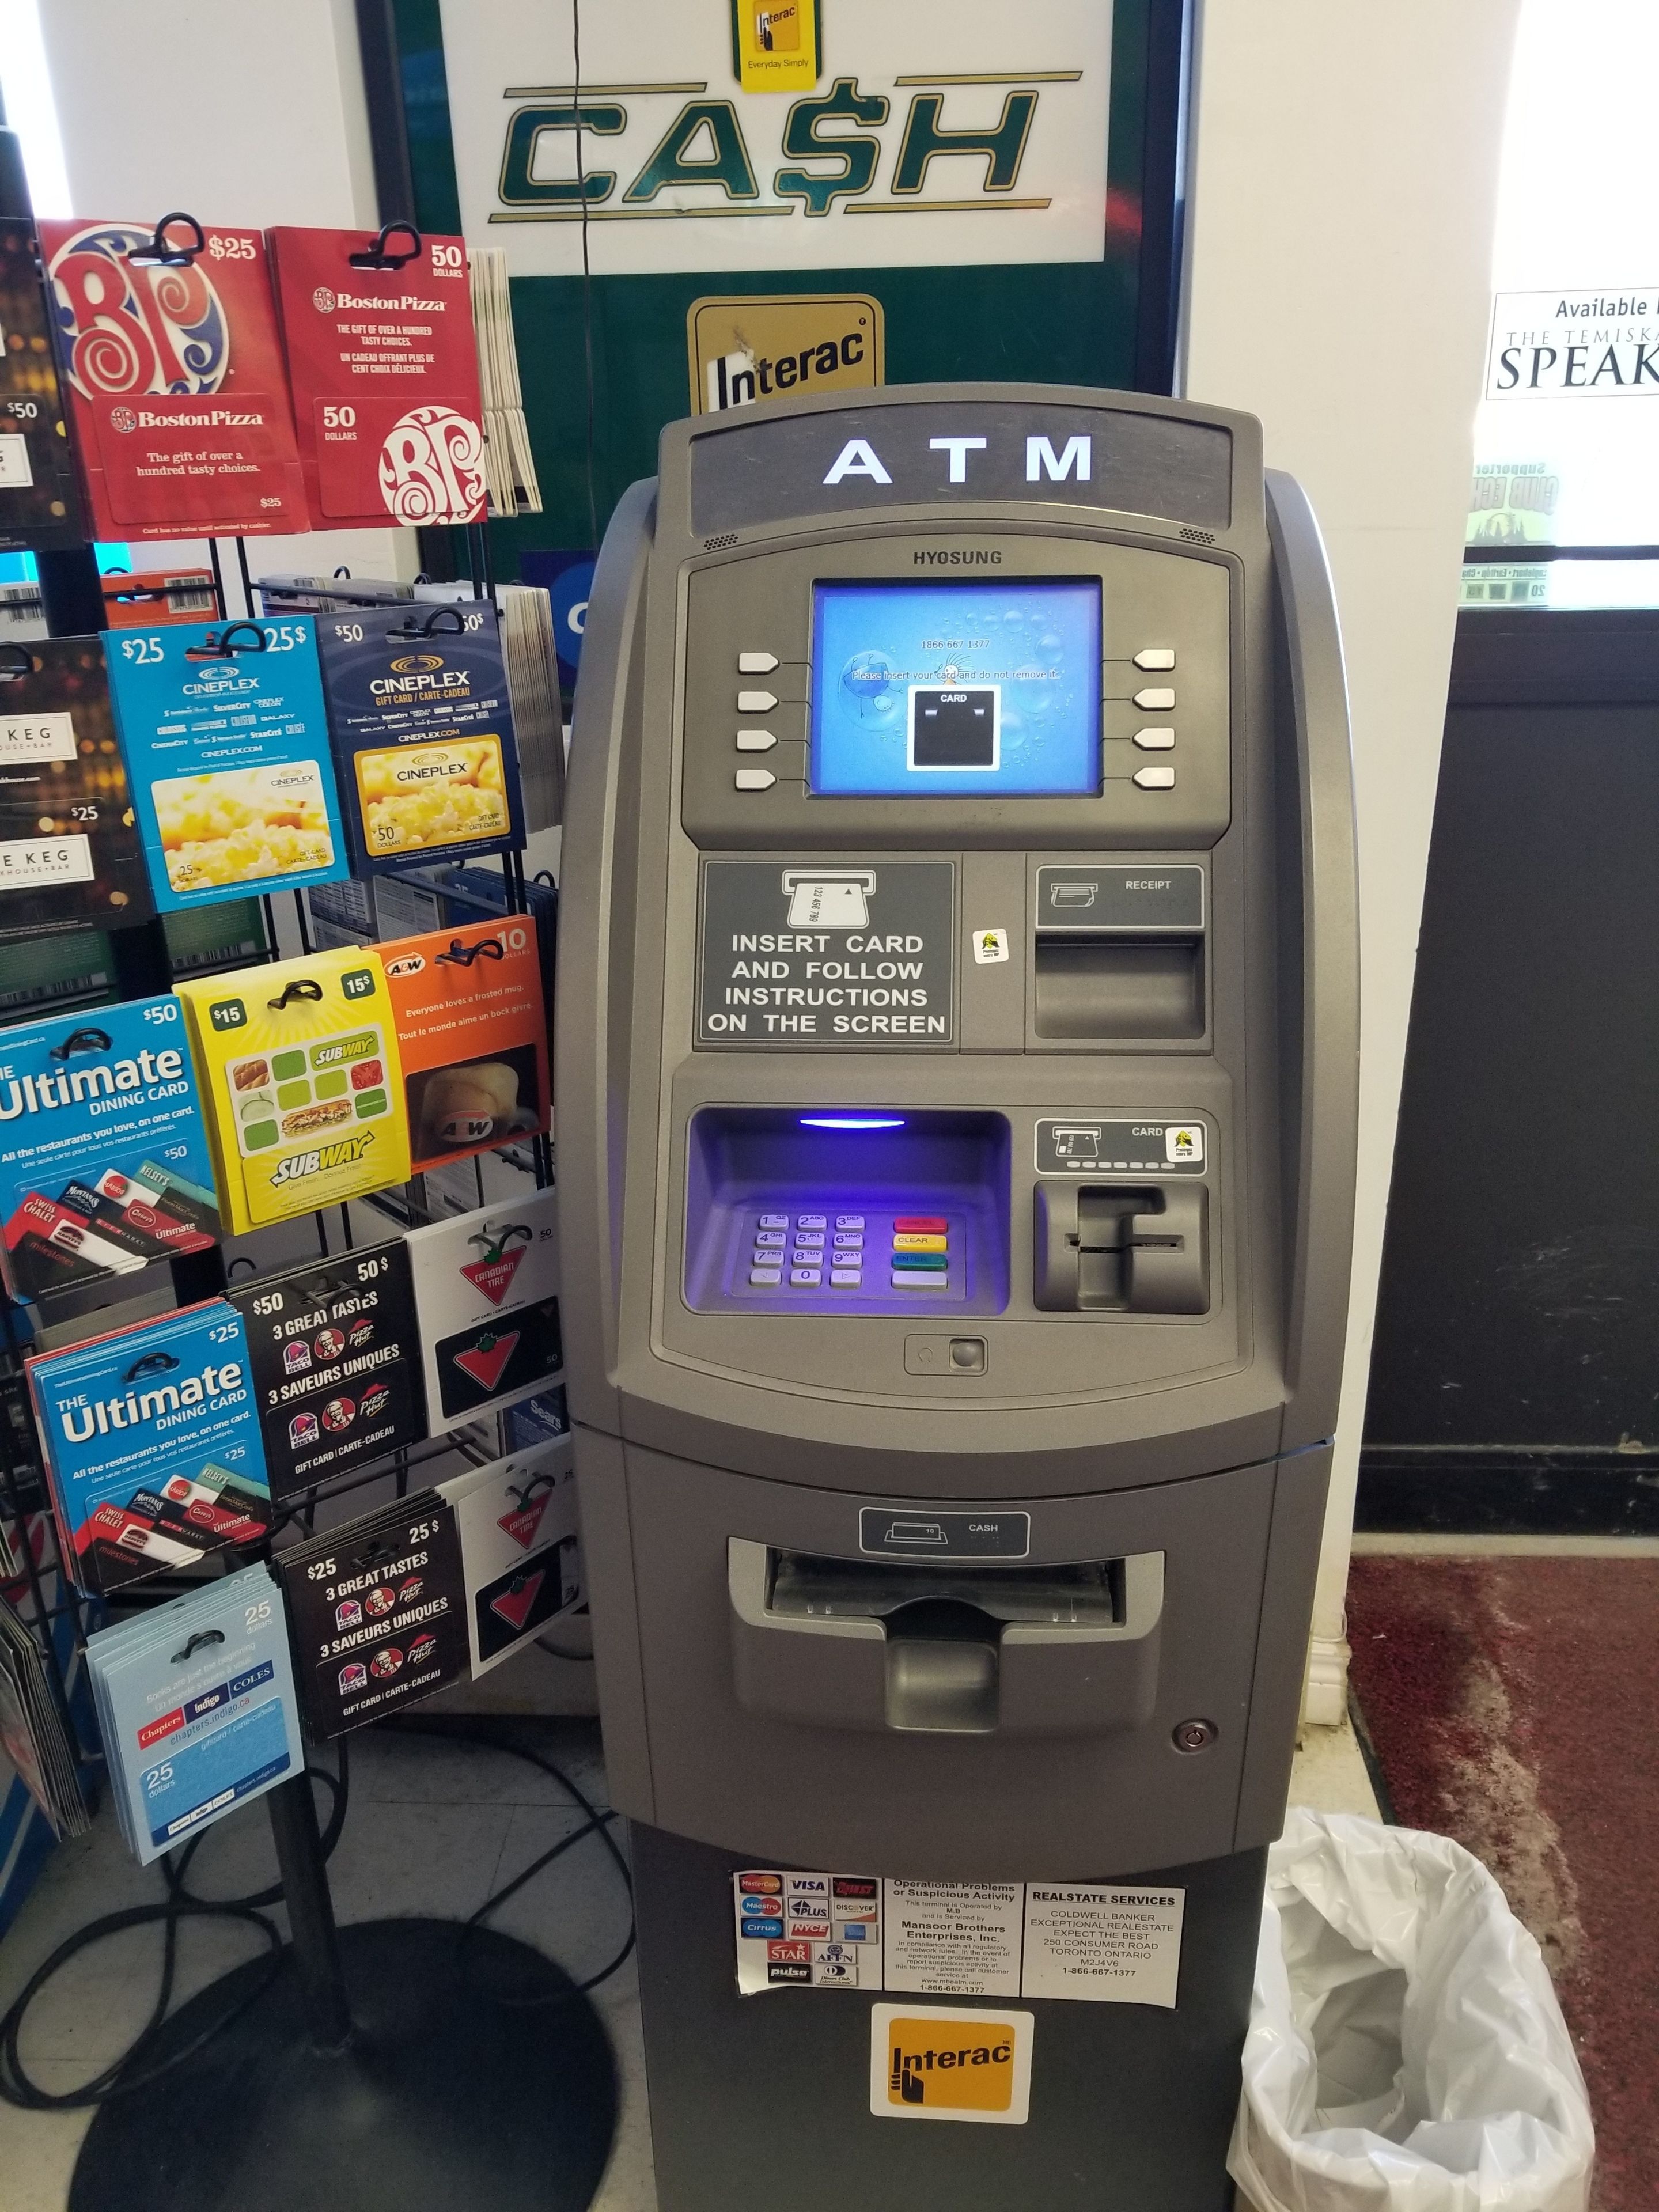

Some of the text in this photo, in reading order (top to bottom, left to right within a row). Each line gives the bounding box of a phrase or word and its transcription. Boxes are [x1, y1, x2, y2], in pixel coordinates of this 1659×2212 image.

[759, 7, 796, 33] Interac
[748, 59, 808, 70] Everyday Simply
[208, 235, 256, 260] $25
[431, 245, 461, 267] 50
[1555, 297, 1647, 318] Available
[1506, 331, 1550, 346] THE
[717, 332, 864, 410] Interac
[1497, 343, 1659, 390] SPEAK
[323, 407, 356, 427] 50
[325, 431, 357, 441] DOLLARS
[147, 453, 169, 462] The
[173, 452, 192, 463] gift
[195, 452, 207, 460] of
[822, 435, 1092, 484] ATM
[137, 464, 260, 476] hundred tasty choices.
[914, 551, 1002, 565] HYOSUNG
[266, 626, 307, 652] 25$
[335, 624, 363, 642] $50
[121, 637, 164, 664] $25
[921, 639, 990, 649] 1866 667 1377
[369, 671, 471, 695] CINEPLEX
[852, 671, 881, 680] Please
[884, 671, 909, 680] insert
[912, 672, 933, 681] your
[935, 670, 956, 680] card
[959, 670, 976, 679] and
[979, 670, 991, 679] do
[994, 671, 1009, 679] not
[1048, 670, 1059, 679] it.
[183, 678, 260, 695] CINEPLEX
[376, 694, 412, 706] GIFT CARD
[940, 694, 967, 703] CARD
[398, 728, 460, 743] CINEPLEX.COM
[202, 745, 263, 759] CINEPLEX.COM
[271, 775, 314, 786] CINEPLEX
[397, 762, 468, 782] CINEPLEX
[71, 806, 98, 821] $25
[378, 827, 394, 841] 50
[25, 850, 68, 864] KEG
[180, 865, 193, 876] 25
[1126, 881, 1171, 889] RECEIPT
[732, 934, 923, 953] INSERT CARD
[391, 959, 422, 974] A&W
[731, 961, 923, 979] AND FOLLOW
[346, 975, 370, 994] 15$
[406, 1003, 444, 1018] Everyone
[445, 998, 467, 1008] loves
[475, 988, 503, 1001] frosted
[505, 984, 524, 994] mug.
[725, 987, 927, 1006] INSTRUCTIONS
[143, 1004, 177, 1025] $50
[214, 1006, 241, 1024] $15
[398, 1031, 417, 1041] Tout
[419, 1028, 426, 1036] le
[429, 1021, 456, 1033] monde
[458, 1016, 478, 1026] aime
[479, 1013, 489, 1021] un
[491, 1007, 510, 1018] bock
[707, 1014, 945, 1033] ON THE SCREEN
[315, 1035, 375, 1066] SUBWAY
[89, 1081, 189, 1116] DINING CARD
[1, 1105, 195, 1164] All the restaurants you love, on one card.
[1132, 1127, 1164, 1137] CARD
[164, 1146, 187, 1160] $50
[269, 1130, 376, 1188] SUBWAY
[140, 1165, 169, 1186] KELSEY'S
[475, 1262, 514, 1283] CANADIAN
[487, 1276, 505, 1289] TIRE
[252, 1292, 284, 1315] $50
[209, 1323, 239, 1343] $25
[281, 1343, 401, 1400] SAVEURS UNIQUES
[56, 1394, 88, 1411] THE
[62, 1363, 242, 1443] Ultimate
[157, 1389, 247, 1430] DINING CARD
[531, 1399, 562, 1431] Sears
[224, 1446, 246, 1461] $25
[295, 1451, 334, 1474] GIFT CARD
[969, 1524, 998, 1532] CASH
[307, 1558, 336, 1580] $25
[338, 1552, 429, 1597] GREAT TASTES
[244, 1600, 271, 1626] 25
[332, 1597, 448, 1653] SAVEURS UNIQUES
[141, 1667, 271, 1741] Chapters Indigo COLES
[171, 1696, 249, 1745] chapters.indigo.ca
[742, 1880, 779, 1888] MasterCard
[792, 1880, 825, 1891] VISA
[893, 1880, 1015, 1892] Operational Problems
[908, 1889, 969, 1899] Suspicious
[973, 1892, 1015, 1903] Activity
[1033, 1892, 1175, 1906] REALSTATE SERVICES
[800, 1908, 827, 1917] PLUS
[1051, 1911, 1155, 1921] COLDWELL BANKER
[796, 1925, 827, 1933] NYCE
[902, 1921, 1005, 1933] Mansoor Brothers
[1031, 1919, 1173, 1931] EXCEPTIONAL REALESTATE
[907, 1930, 1000, 1942] Enterprises, Inc.
[1064, 1940, 1125, 1948] CONSUMER
[772, 1950, 806, 1960] STAR
[1050, 1948, 1151, 1959] TORONTO ONTARIO
[1062, 1967, 1136, 1976] 1-866-667-1377
[1081, 1959, 1119, 1967] M2J4V6
[893, 2045, 1010, 2074] Interac
